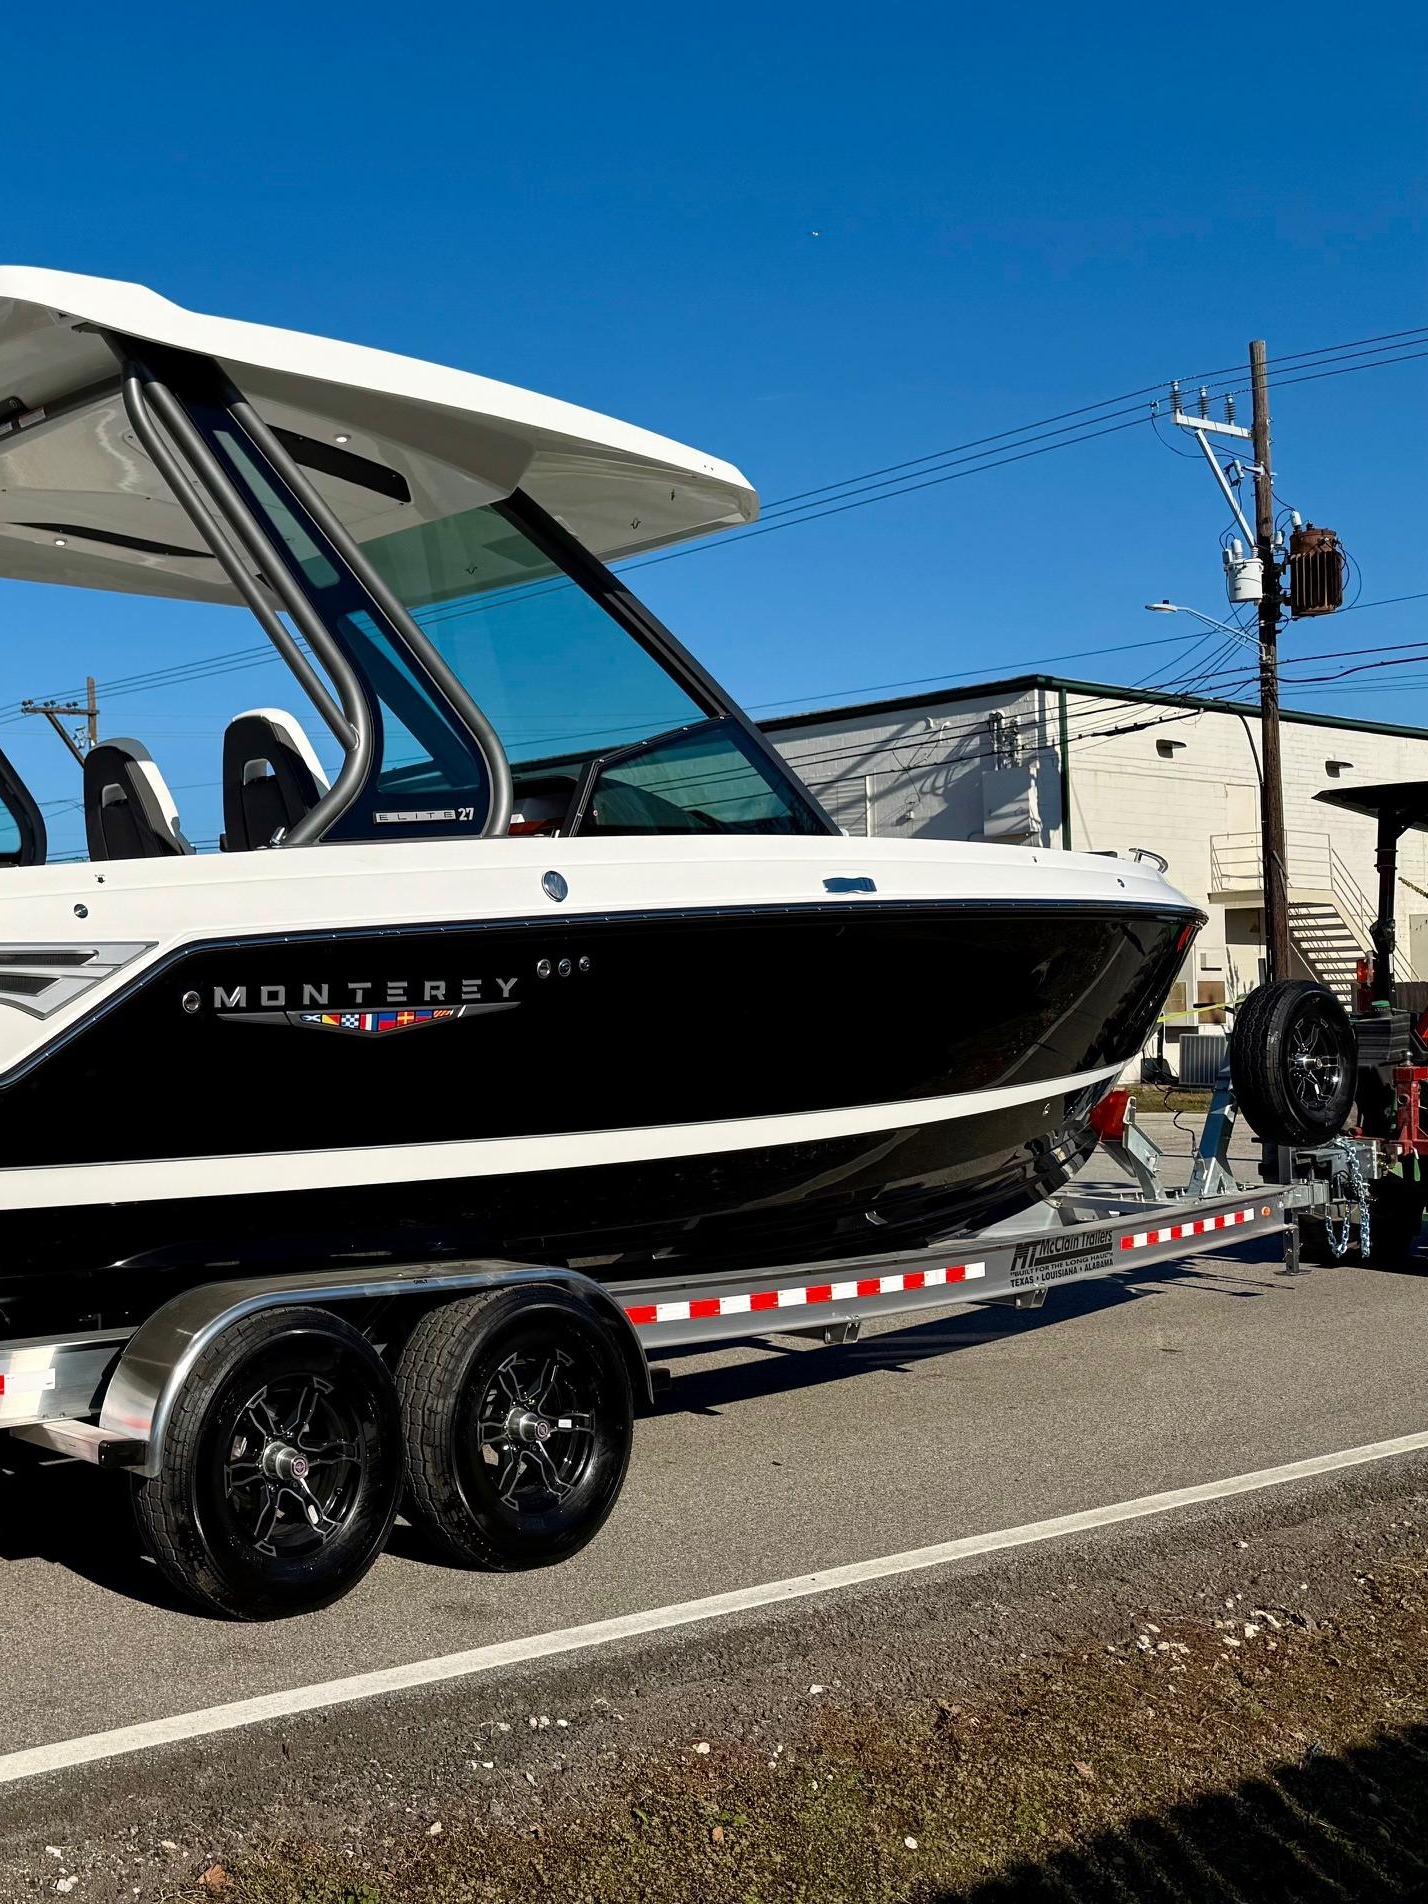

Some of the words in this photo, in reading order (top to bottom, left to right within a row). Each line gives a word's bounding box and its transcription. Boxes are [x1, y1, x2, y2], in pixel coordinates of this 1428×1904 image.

[378, 811, 454, 820] ELITE
[458, 808, 474, 820] 27
[213, 978, 518, 1007] MONTEREY
[1039, 1234, 1079, 1256] McClain
[1081, 1230, 1113, 1247] Trailers
[1010, 1275, 1034, 1288] TEXAS
[1041, 1266, 1078, 1282] LOUISIANA
[1084, 1258, 1114, 1272] ALABAMA
[1036, 1264, 1050, 1273] FOR
[1051, 1262, 1064, 1270] THE
[1065, 1257, 1089, 1267] LONG
